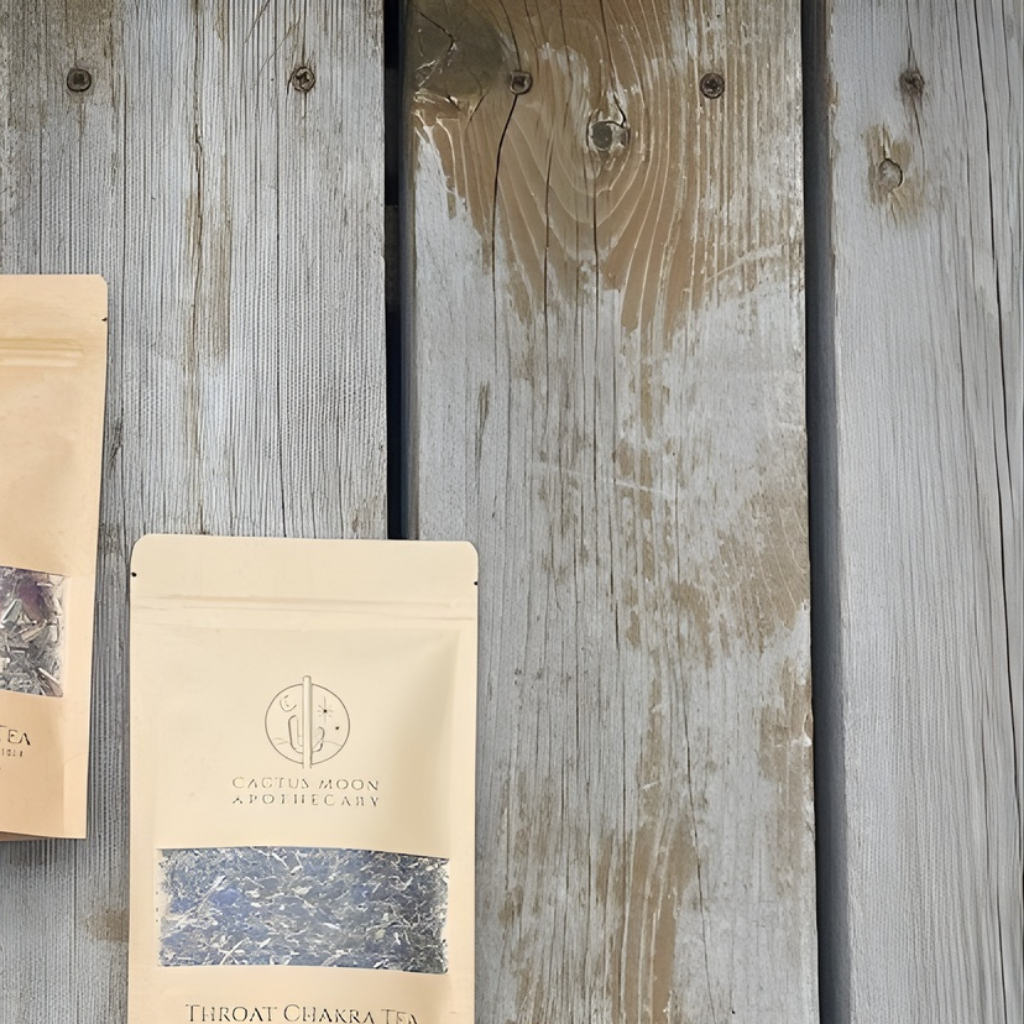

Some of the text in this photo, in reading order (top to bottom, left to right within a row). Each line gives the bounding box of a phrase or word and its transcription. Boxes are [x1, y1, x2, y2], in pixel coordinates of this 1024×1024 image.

[232, 777, 379, 791] CACTUS MOON
[185, 1004, 277, 1022] THROAT
[283, 1004, 375, 1024] CHAKRA
